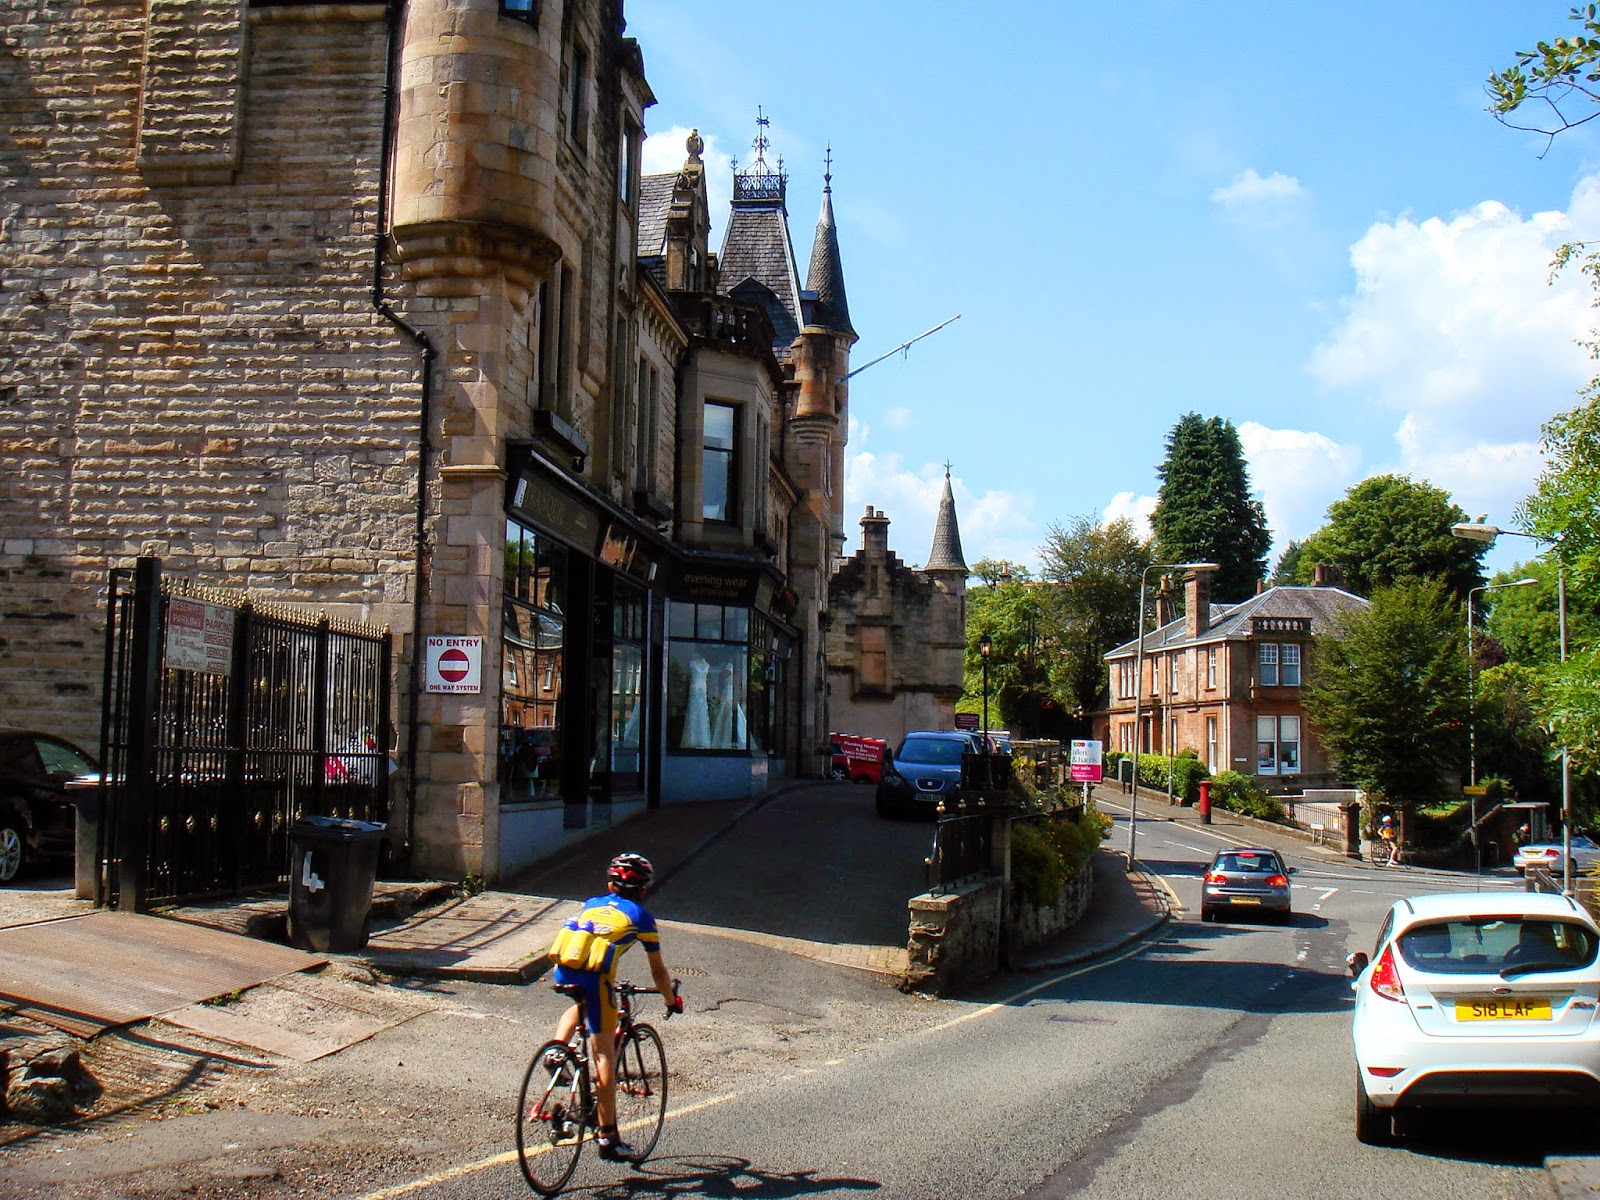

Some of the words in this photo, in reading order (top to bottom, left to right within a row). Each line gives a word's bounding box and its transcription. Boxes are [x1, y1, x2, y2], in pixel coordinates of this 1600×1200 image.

[684, 574, 722, 588] evening
[724, 577, 748, 588] wear
[171, 600, 204, 615] RESERVED
[214, 609, 225, 619] NO
[172, 614, 201, 627] PARKING
[205, 620, 232, 633] PARKING
[429, 639, 443, 647] NO
[447, 639, 479, 647] ENTRY
[206, 646, 228, 658] SERVICES
[302, 851, 326, 893] 4
[1503, 1002, 1534, 1017] LAF
